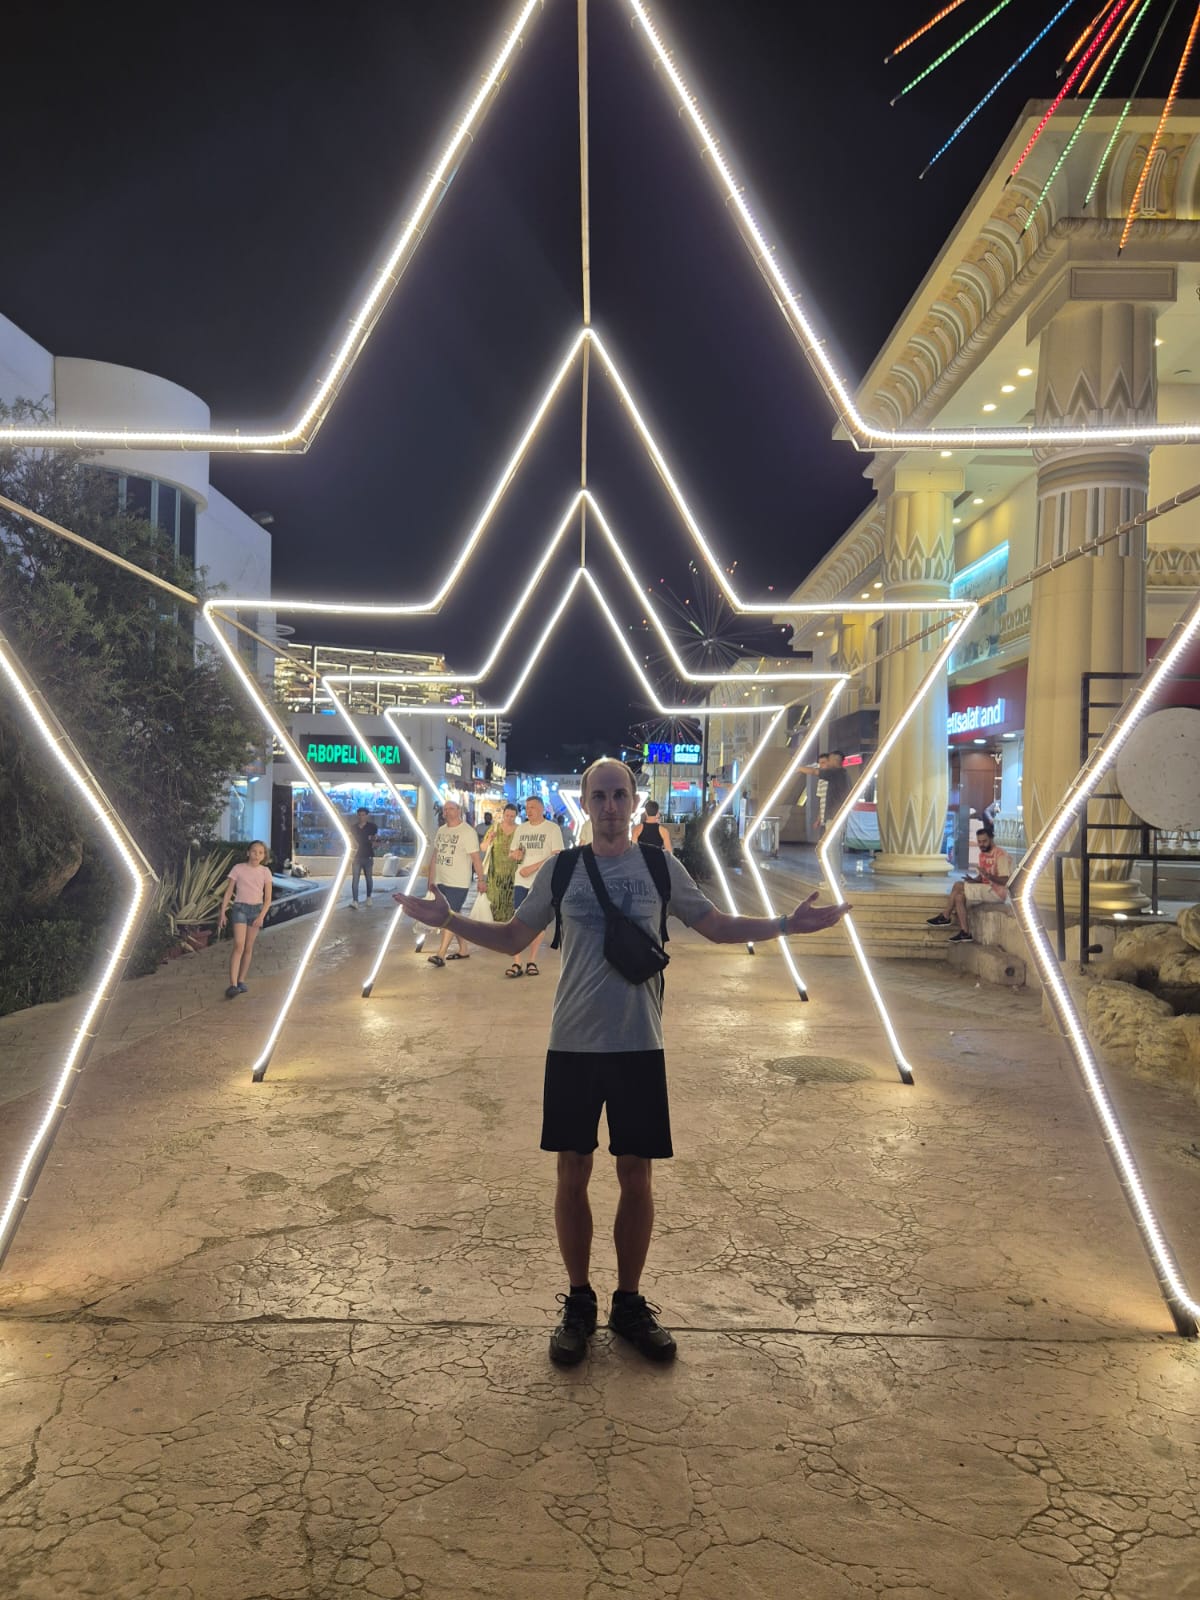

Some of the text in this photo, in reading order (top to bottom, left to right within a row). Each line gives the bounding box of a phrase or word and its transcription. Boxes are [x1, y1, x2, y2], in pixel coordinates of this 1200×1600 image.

[947, 698, 1004, 735] etisalat and
[307, 744, 358, 764] ДВОРЕЦ
